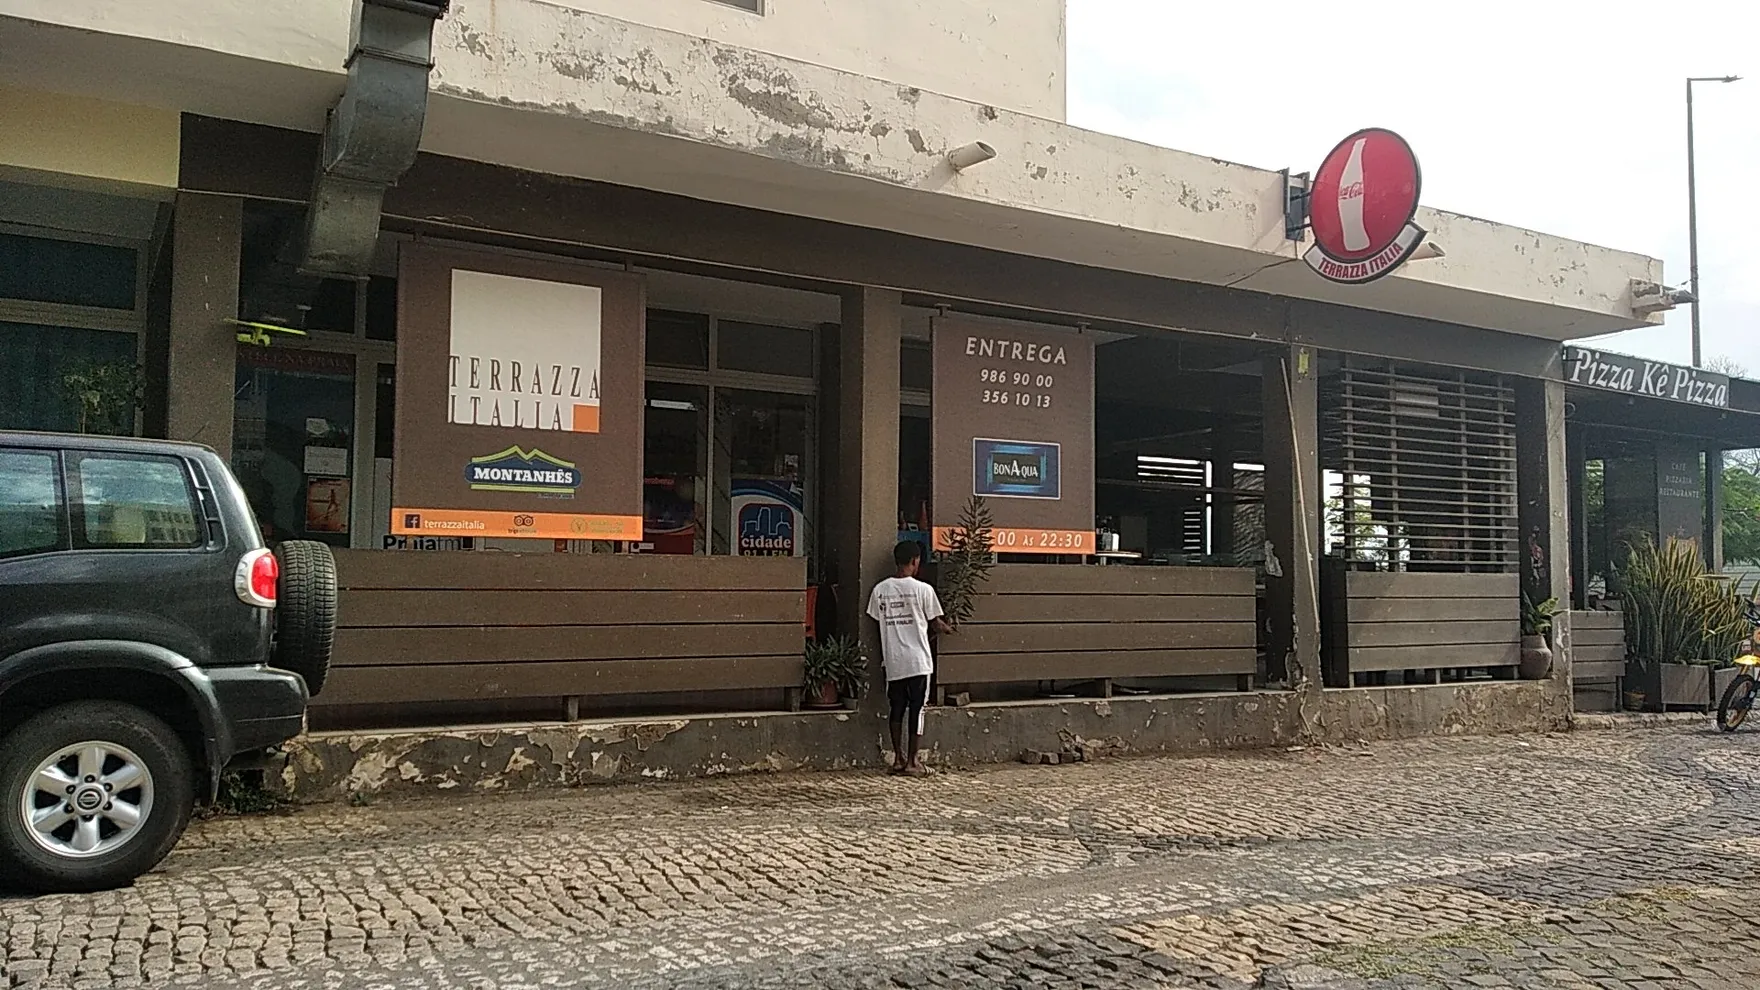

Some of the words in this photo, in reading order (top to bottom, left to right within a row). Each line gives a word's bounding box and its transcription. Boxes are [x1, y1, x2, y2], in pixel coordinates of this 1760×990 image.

[1318, 257, 1368, 278] TERRAZZA
[1369, 242, 1403, 273] ITALIA
[966, 337, 1066, 364] ENTREGA
[450, 355, 600, 399] TERRAZZA
[981, 368, 1007, 383] 986
[1013, 372, 1030, 385] 90
[1036, 374, 1053, 388] 00
[1570, 348, 1635, 392] Pizza
[1638, 361, 1670, 396] Kê
[1670, 368, 1728, 407] Pizza
[982, 390, 1009, 405] 356
[1015, 392, 1030, 406] 10
[1036, 395, 1051, 408] 13
[450, 394, 562, 431] ITALIA
[473, 467, 573, 484] MONTANHÊS
[1659, 487, 1700, 499] RESTAURANTE
[424, 520, 485, 531] terrazzaitalia
[741, 535, 791, 548] cidade
[1040, 532, 1082, 548] 22:30
